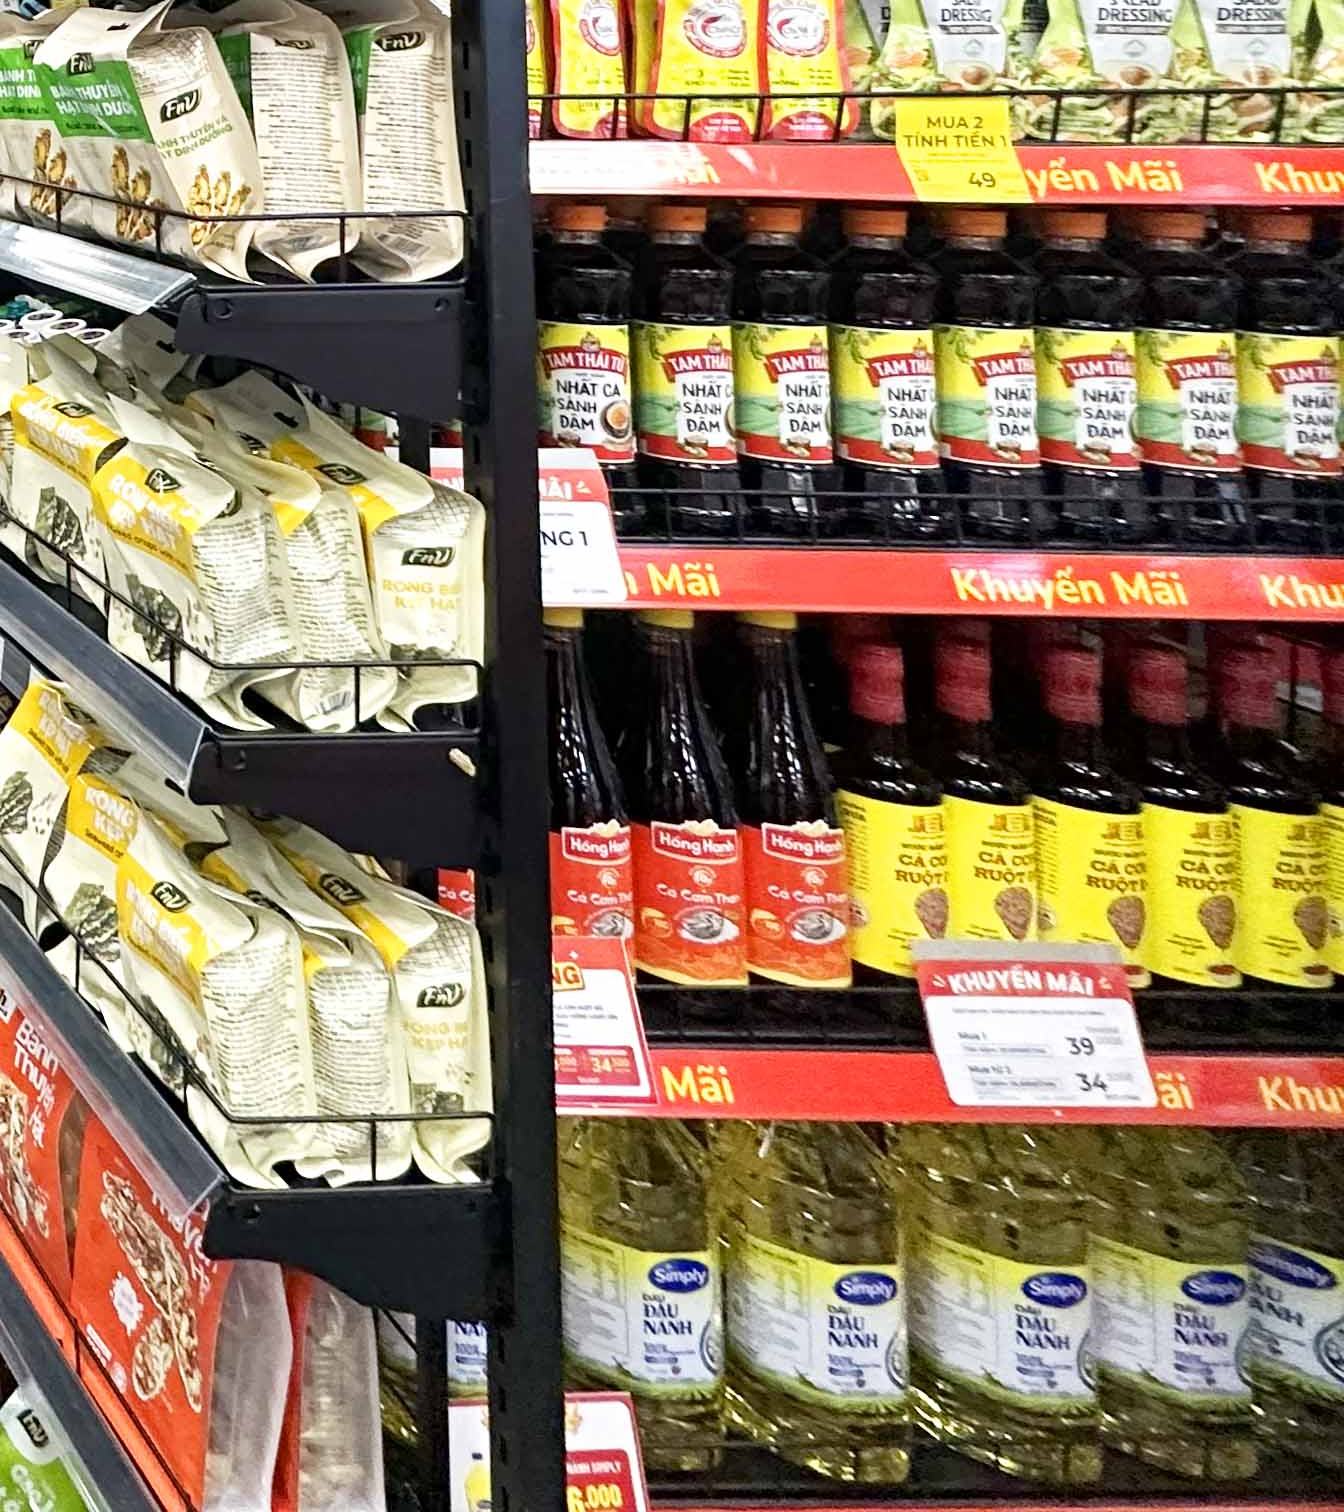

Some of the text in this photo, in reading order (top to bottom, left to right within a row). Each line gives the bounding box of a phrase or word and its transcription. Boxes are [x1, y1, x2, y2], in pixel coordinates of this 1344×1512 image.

[1099, 7, 1173, 23] DRESSING
[926, 115, 984, 130] MUA 2
[968, 170, 997, 190] 49
[1026, 157, 1183, 199] yến Mãi
[546, 352, 575, 370] TAM
[670, 355, 702, 373] TAM
[652, 563, 721, 598] Mãi
[951, 564, 1189, 609] Khuyến Mãi
[1065, 1037, 1096, 1057] 39
[1075, 1072, 1108, 1092] 34
[653, 1263, 708, 1286] Simply
